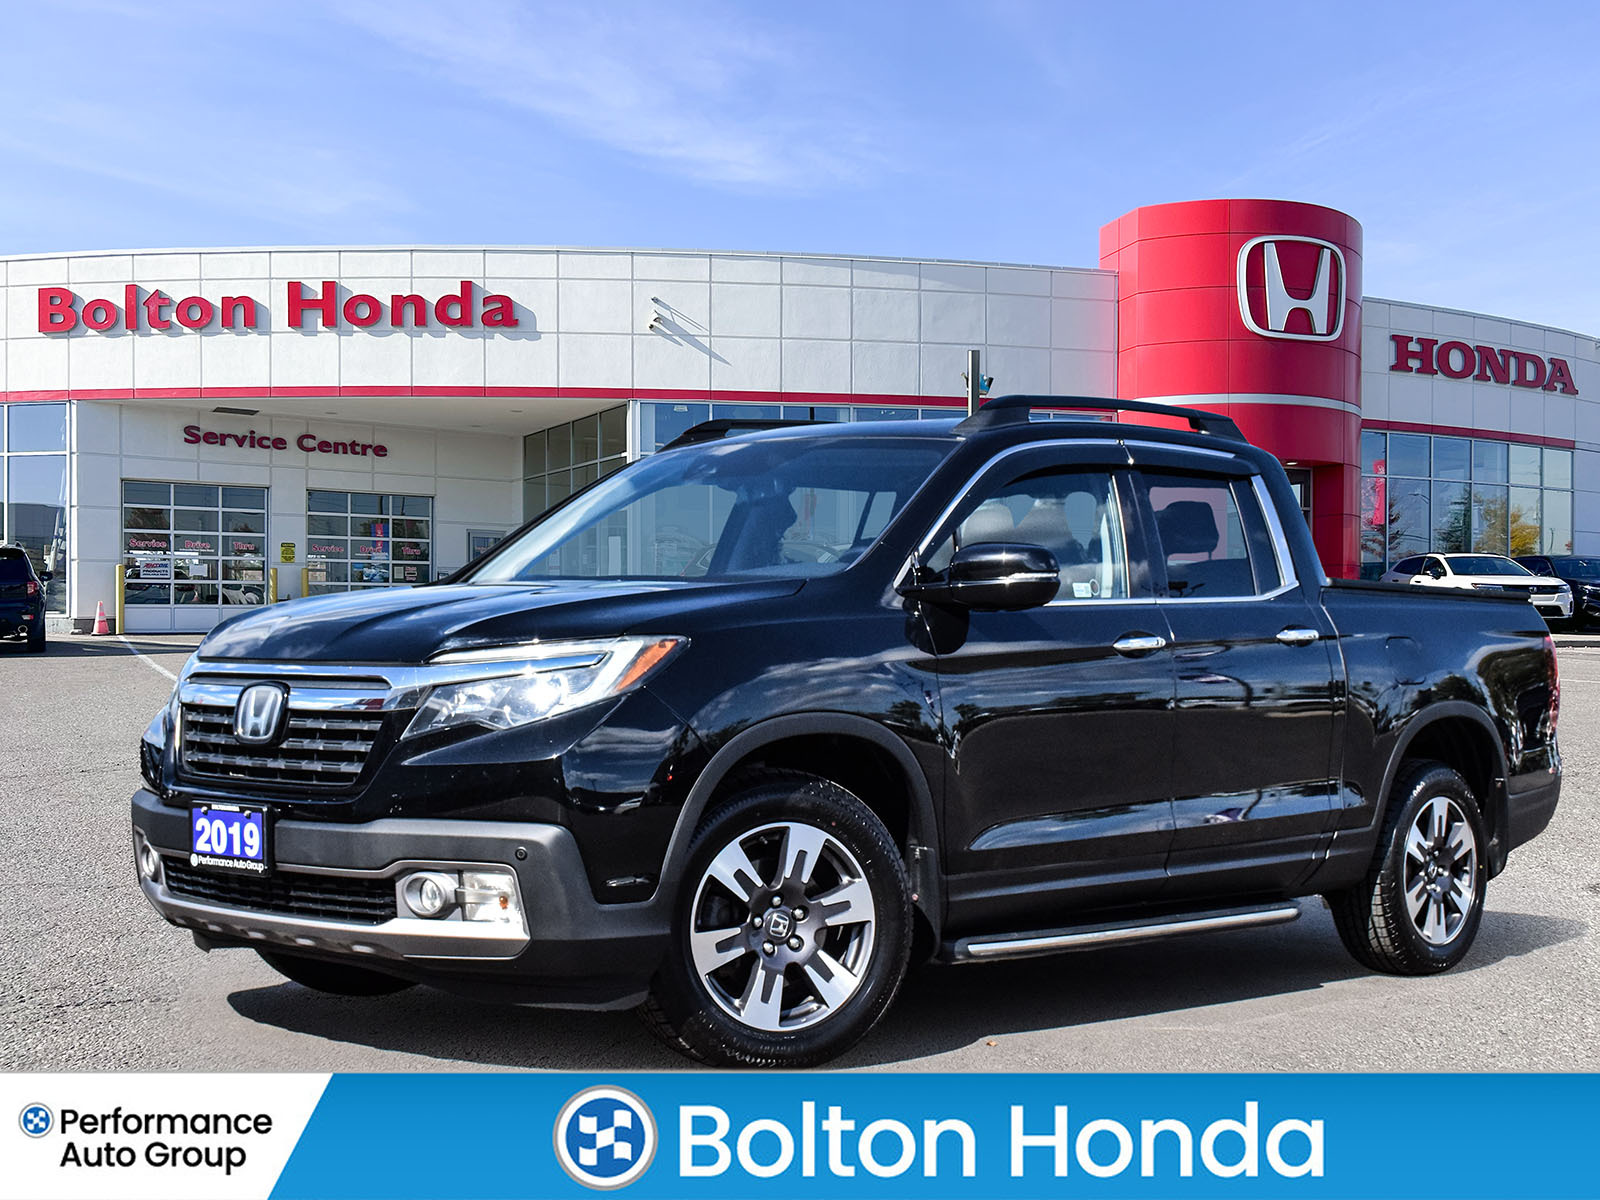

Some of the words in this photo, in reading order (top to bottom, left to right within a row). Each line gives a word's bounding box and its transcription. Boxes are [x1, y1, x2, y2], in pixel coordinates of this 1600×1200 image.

[38, 283, 256, 334] Bolton
[287, 280, 519, 328] Honda
[1390, 334, 1578, 395] HONDA
[183, 425, 287, 451] Service
[297, 434, 389, 458] Centre
[129, 538, 167, 548] Service
[184, 540, 211, 549] Drive
[232, 541, 255, 551] Thru
[312, 543, 344, 553] Service
[195, 817, 260, 858] 2019
[198, 855, 233, 868] Performance
[234, 858, 247, 869] Auto
[246, 860, 264, 873] Group
